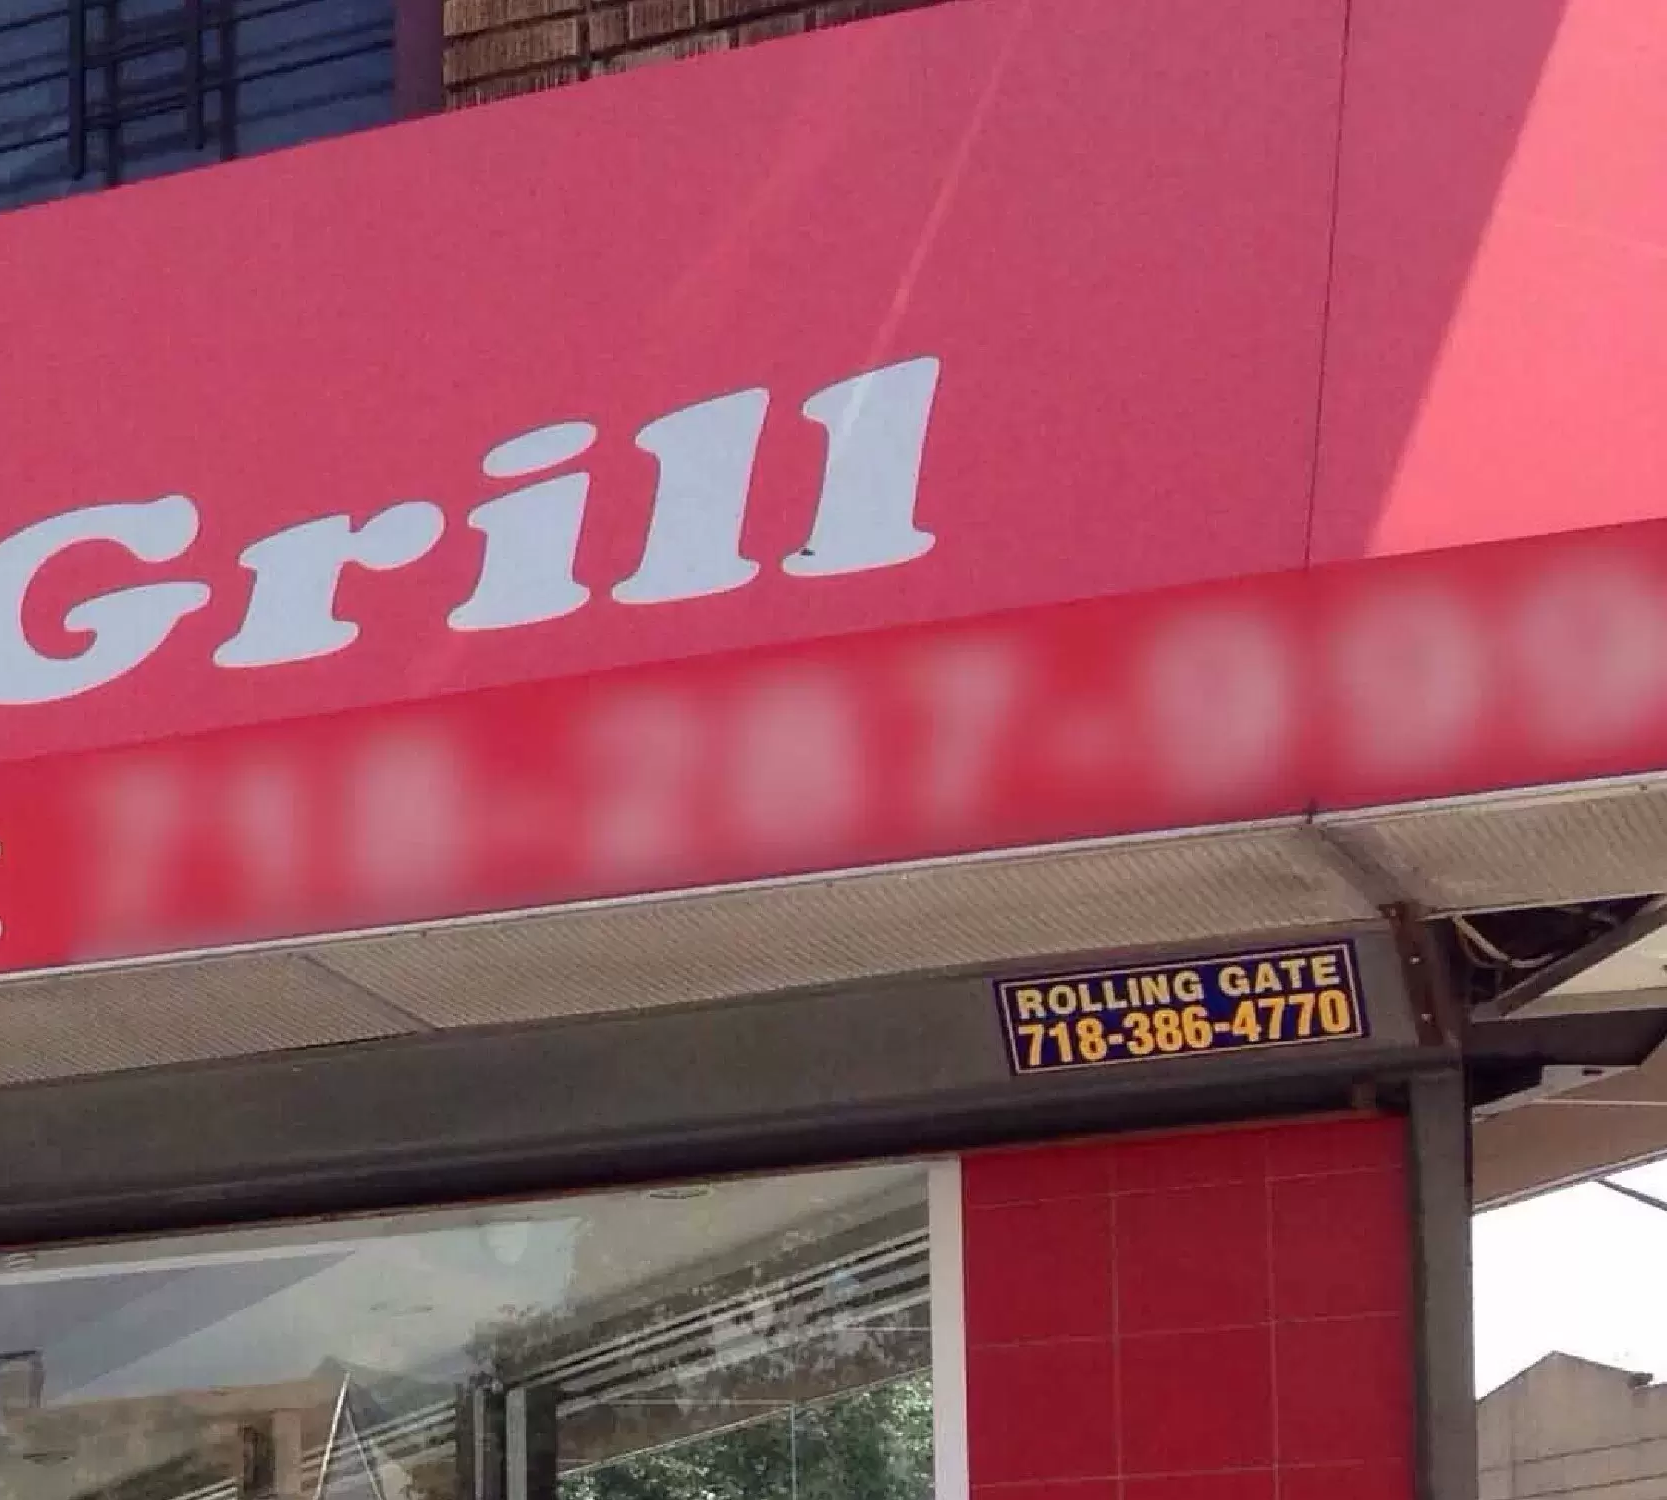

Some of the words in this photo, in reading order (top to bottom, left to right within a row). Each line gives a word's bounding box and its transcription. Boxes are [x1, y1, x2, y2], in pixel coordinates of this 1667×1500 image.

[1016, 971, 1204, 1020] ROLLING
[1219, 954, 1341, 997] GATE
[1018, 989, 1351, 1066] 718-386-4770
